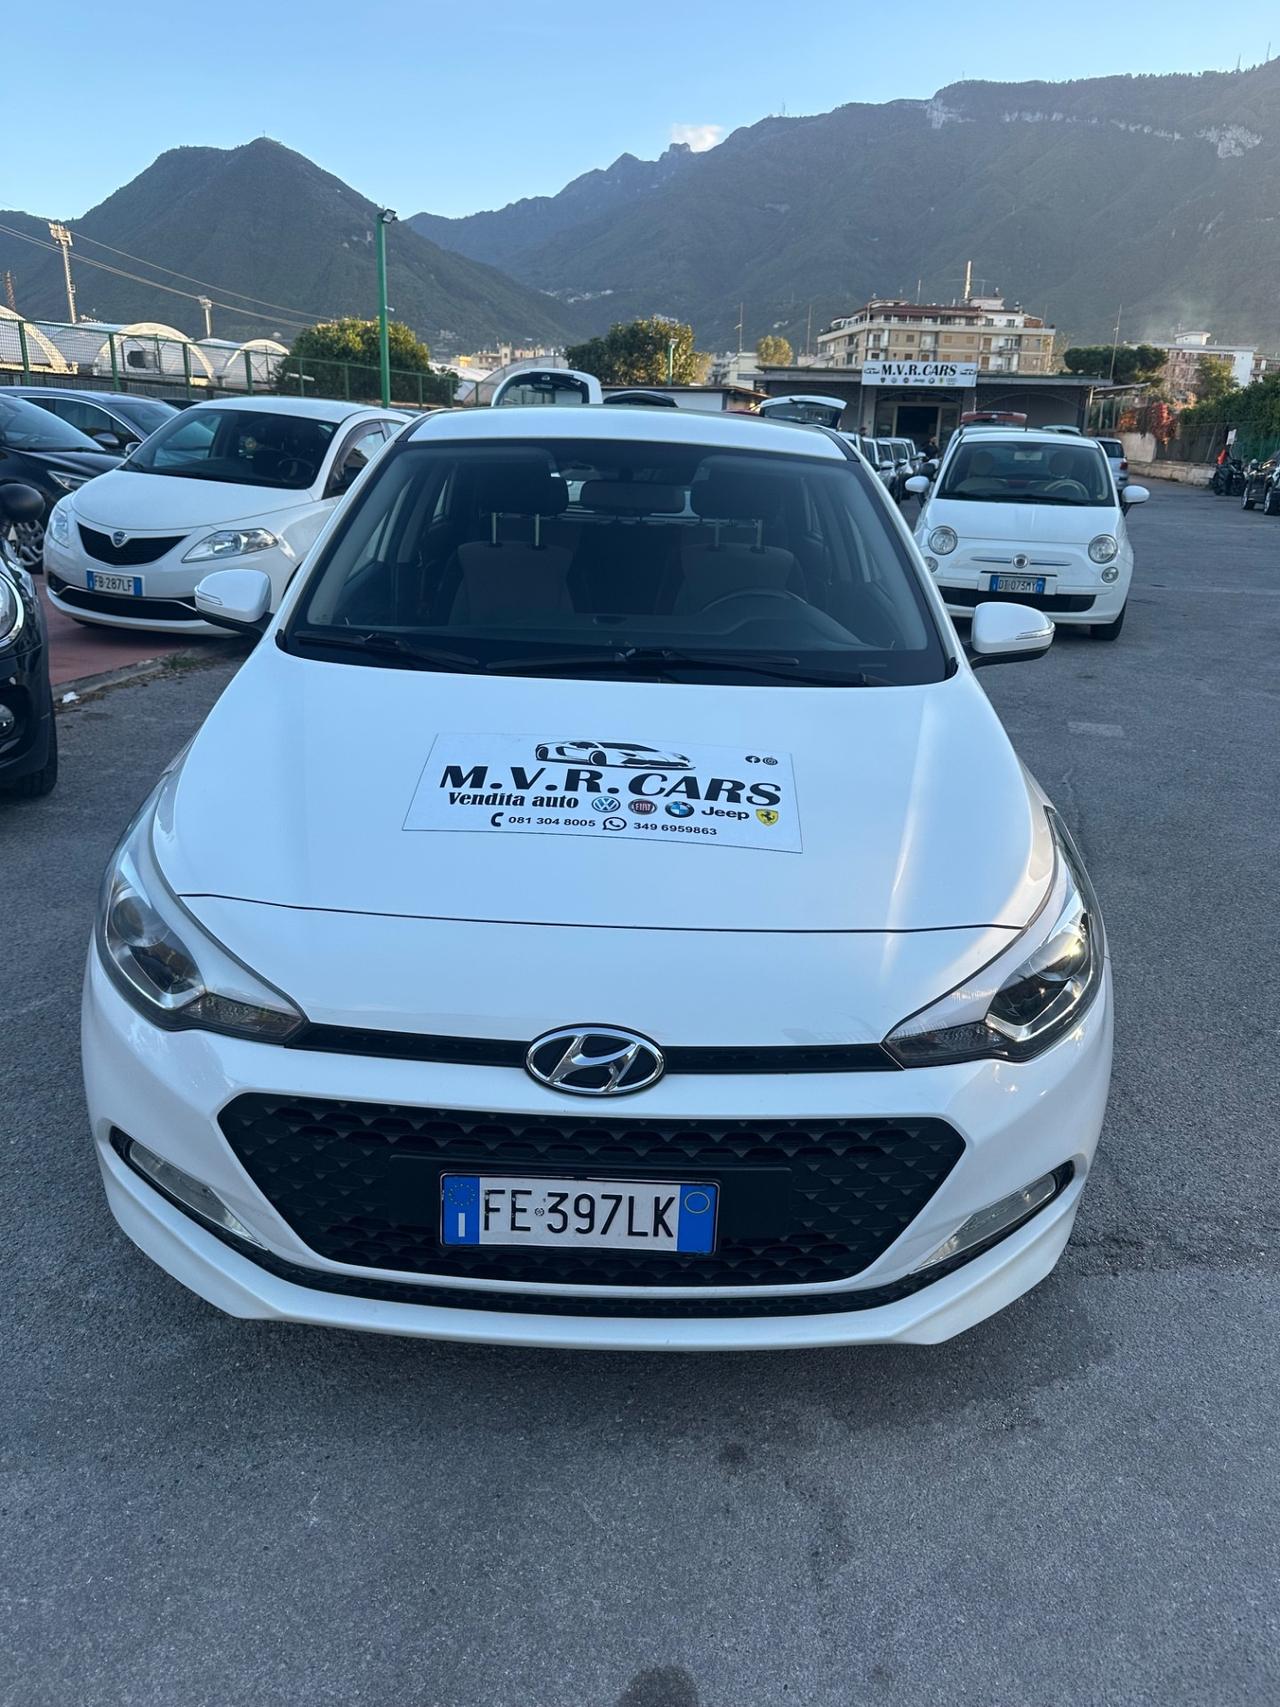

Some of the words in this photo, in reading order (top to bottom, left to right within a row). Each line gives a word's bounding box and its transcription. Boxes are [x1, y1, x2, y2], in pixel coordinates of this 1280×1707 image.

[449, 792, 525, 807] Vendita
[532, 795, 579, 809] auto
[701, 806, 750, 821] Jeep
[508, 816, 532, 825] 081
[536, 817, 560, 826] 304
[563, 818, 596, 827] 8005
[633, 822, 658, 831] 349
[661, 824, 718, 836] 6959863
